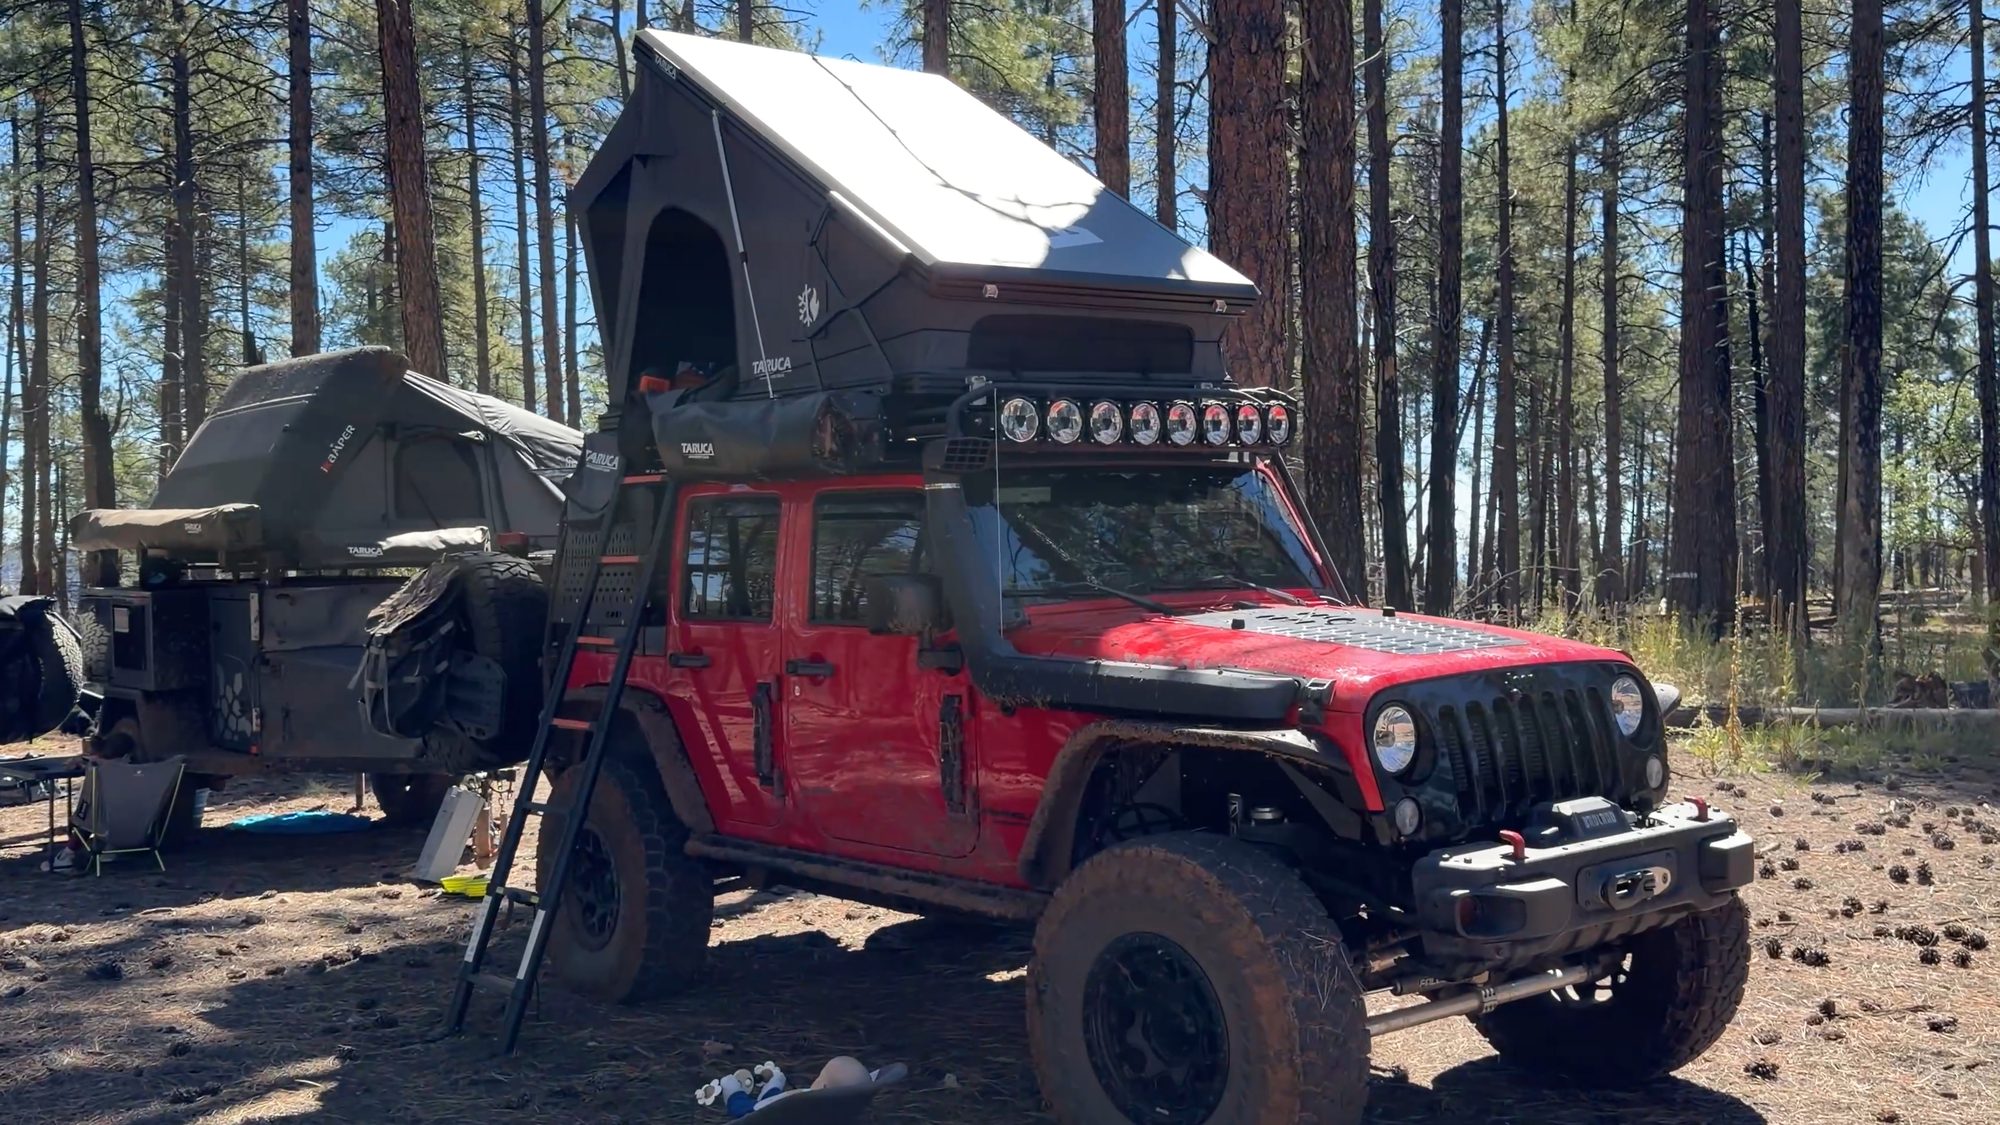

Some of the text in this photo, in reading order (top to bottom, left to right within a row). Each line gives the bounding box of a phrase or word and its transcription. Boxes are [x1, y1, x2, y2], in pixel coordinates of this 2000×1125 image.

[752, 357, 792, 375] TARUCA
[681, 443, 714, 456] TARUCA
[585, 450, 619, 470] TARUCA
[347, 546, 383, 556] TARUCA
